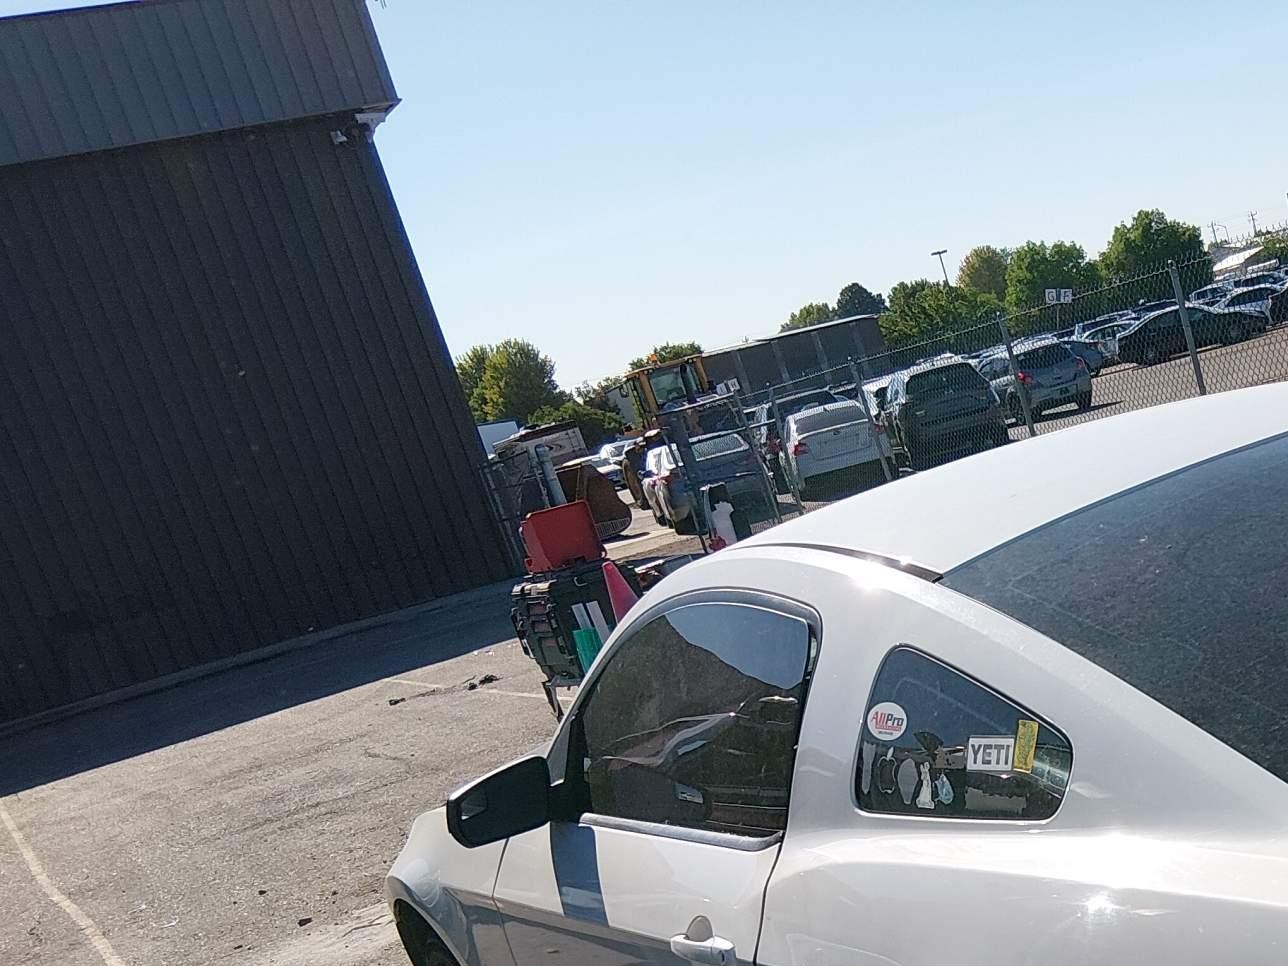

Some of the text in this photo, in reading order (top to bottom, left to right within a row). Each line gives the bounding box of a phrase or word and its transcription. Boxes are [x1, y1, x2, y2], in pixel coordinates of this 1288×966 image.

[1048, 291, 1055, 302] G
[872, 711, 904, 727] AllPro
[970, 743, 1011, 765] YETI
